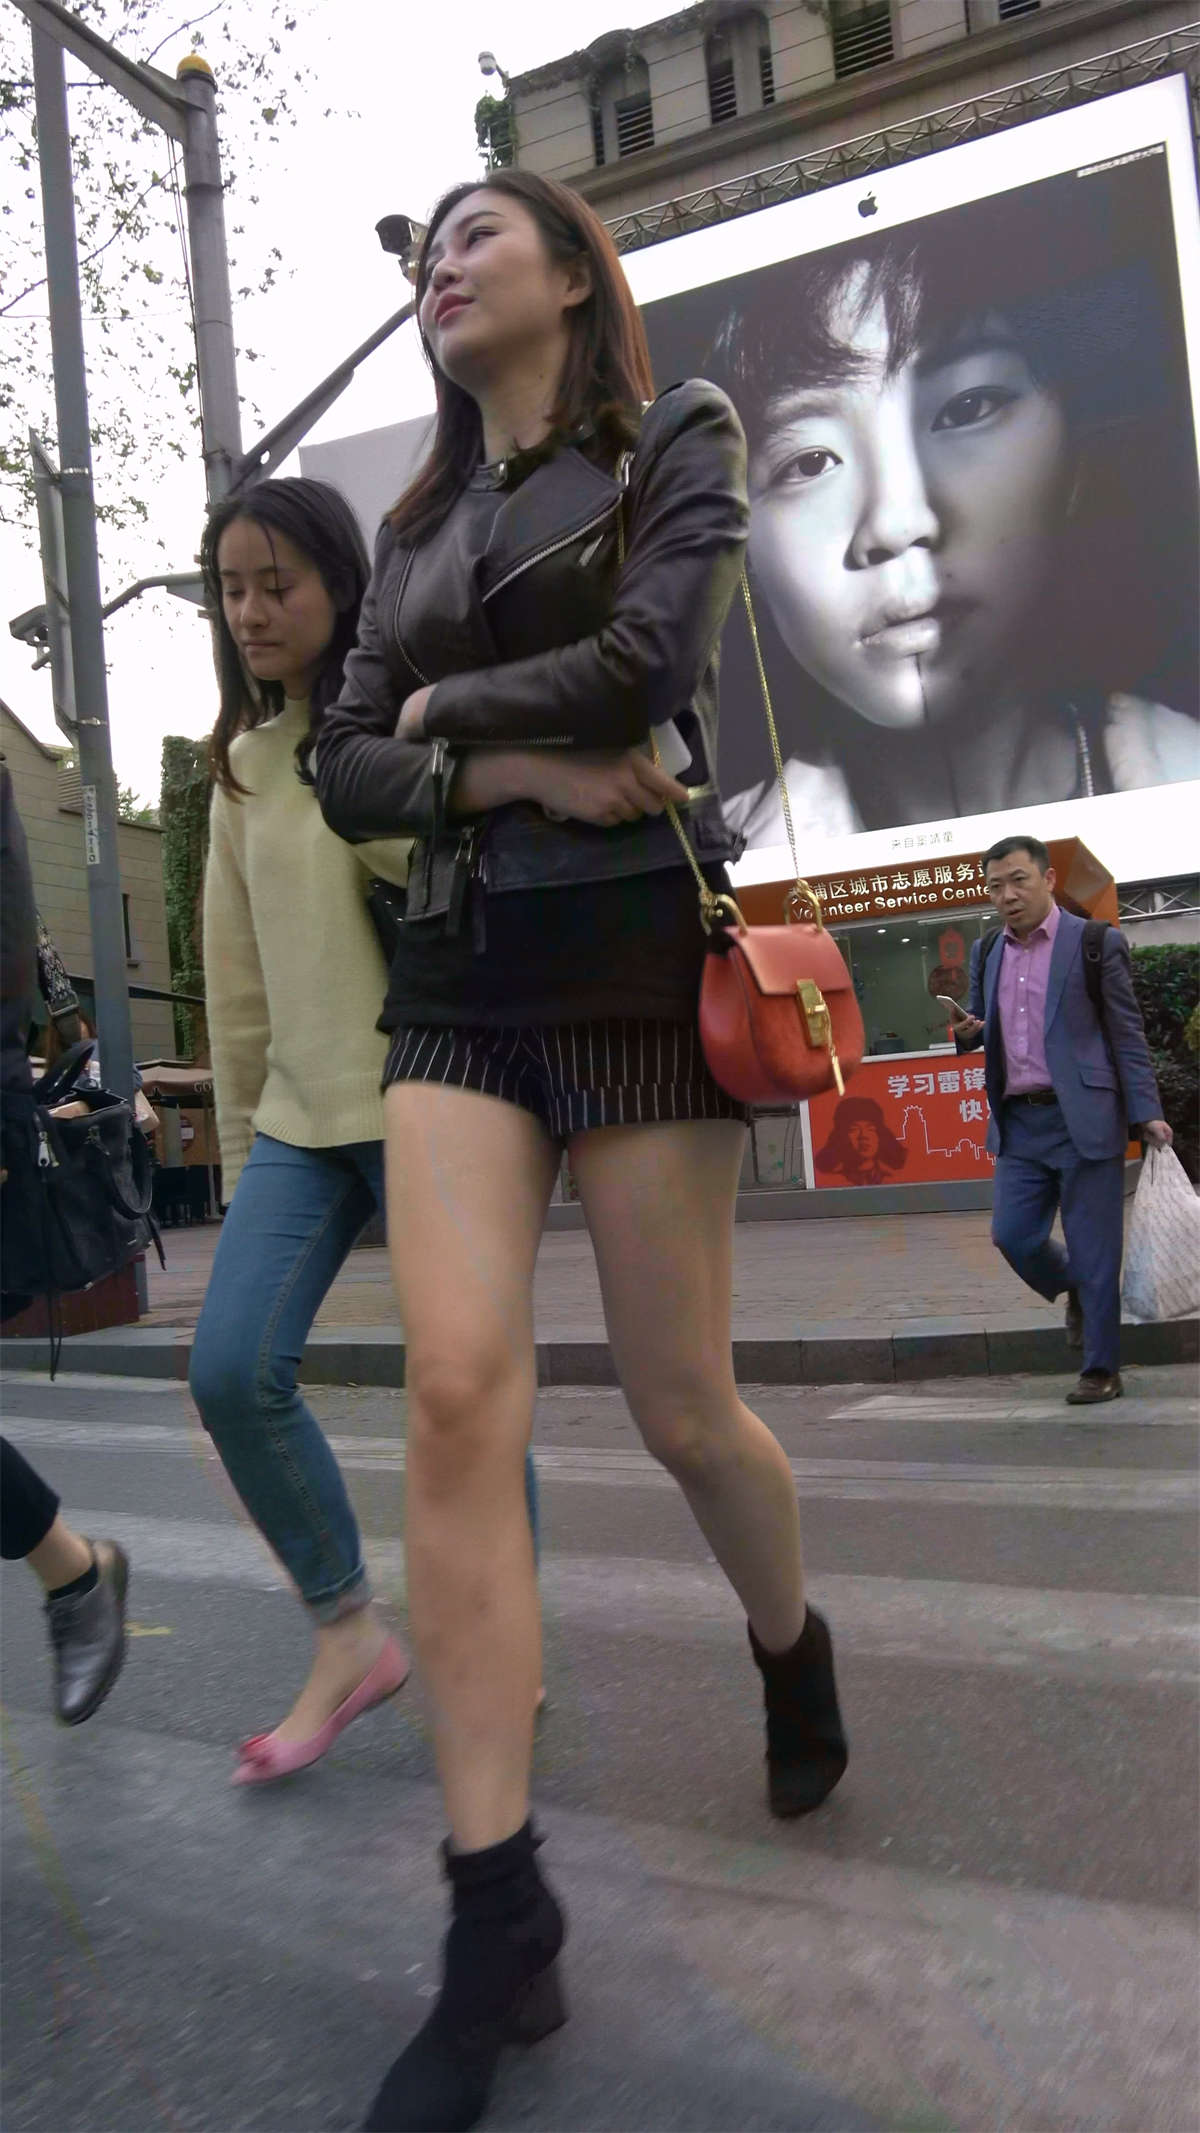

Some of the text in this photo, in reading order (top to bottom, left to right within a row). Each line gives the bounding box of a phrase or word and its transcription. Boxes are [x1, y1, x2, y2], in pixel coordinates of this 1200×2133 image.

[874, 892, 938, 909] Service
[887, 1068, 986, 1098] 学习雷锋
[959, 1098, 992, 1122] 快
